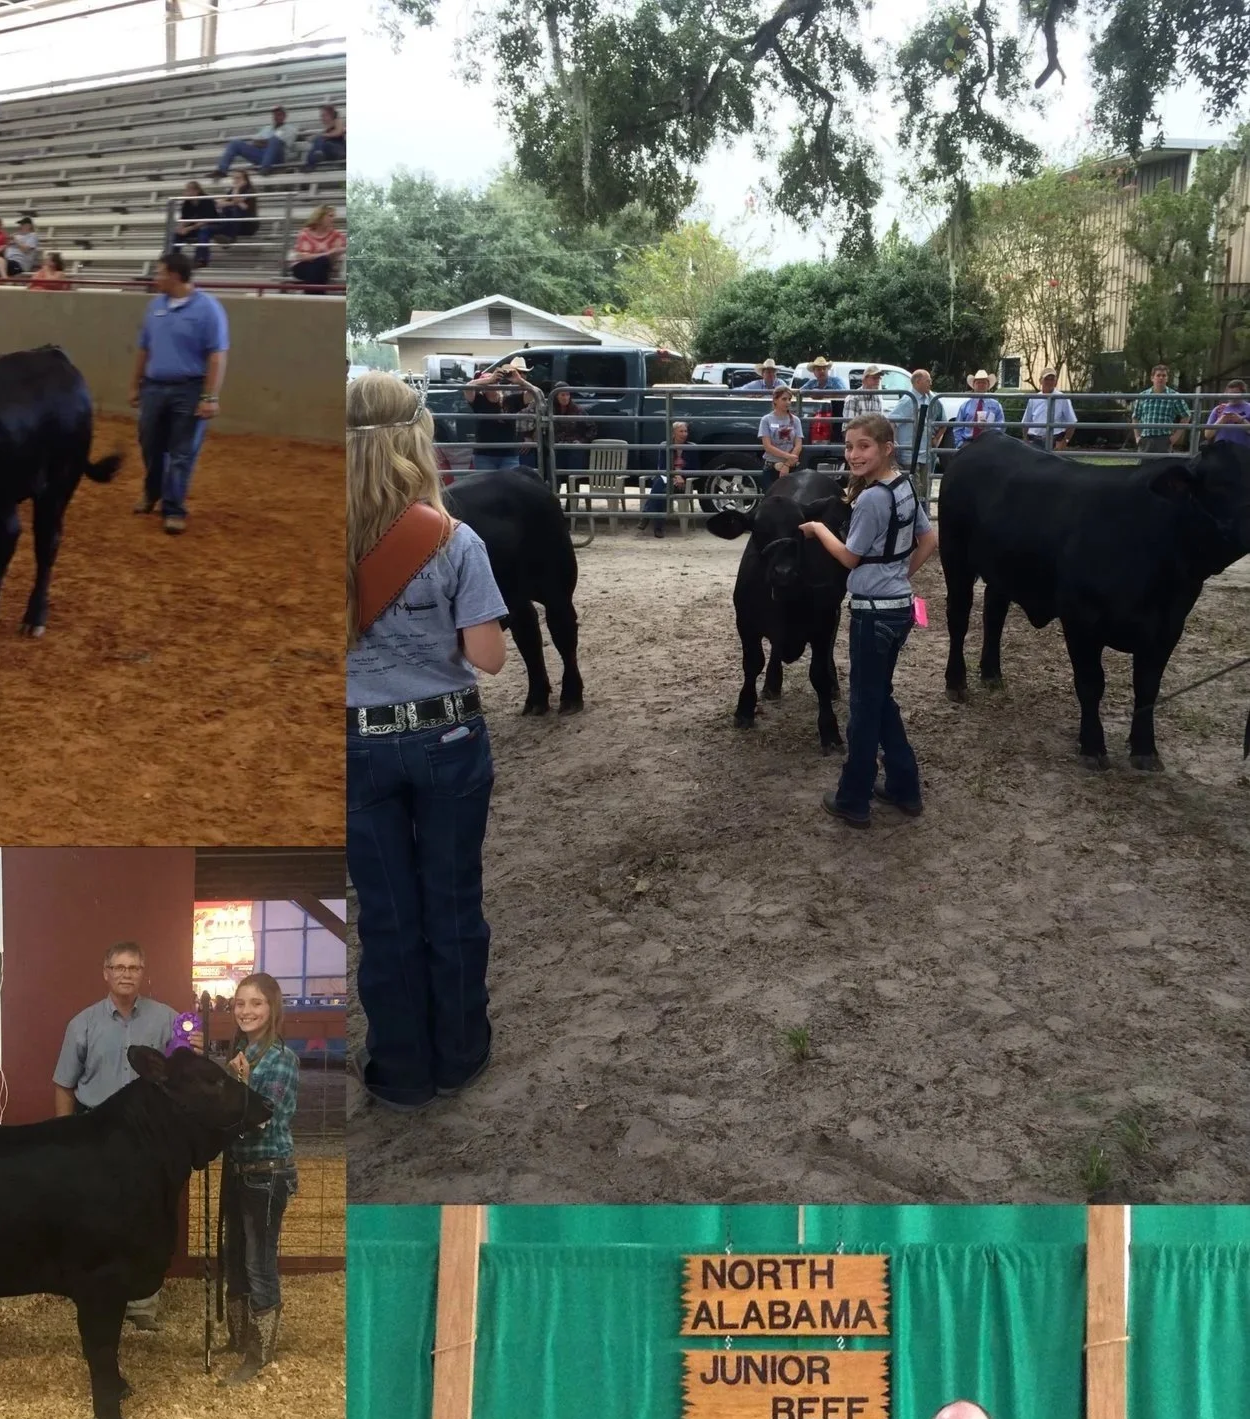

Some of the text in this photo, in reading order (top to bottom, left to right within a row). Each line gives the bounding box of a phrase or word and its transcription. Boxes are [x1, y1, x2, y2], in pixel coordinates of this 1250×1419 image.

[701, 1258, 835, 1291] NORTH
[691, 1299, 878, 1330] ALABAMA
[700, 1354, 831, 1386] JUNIOR
